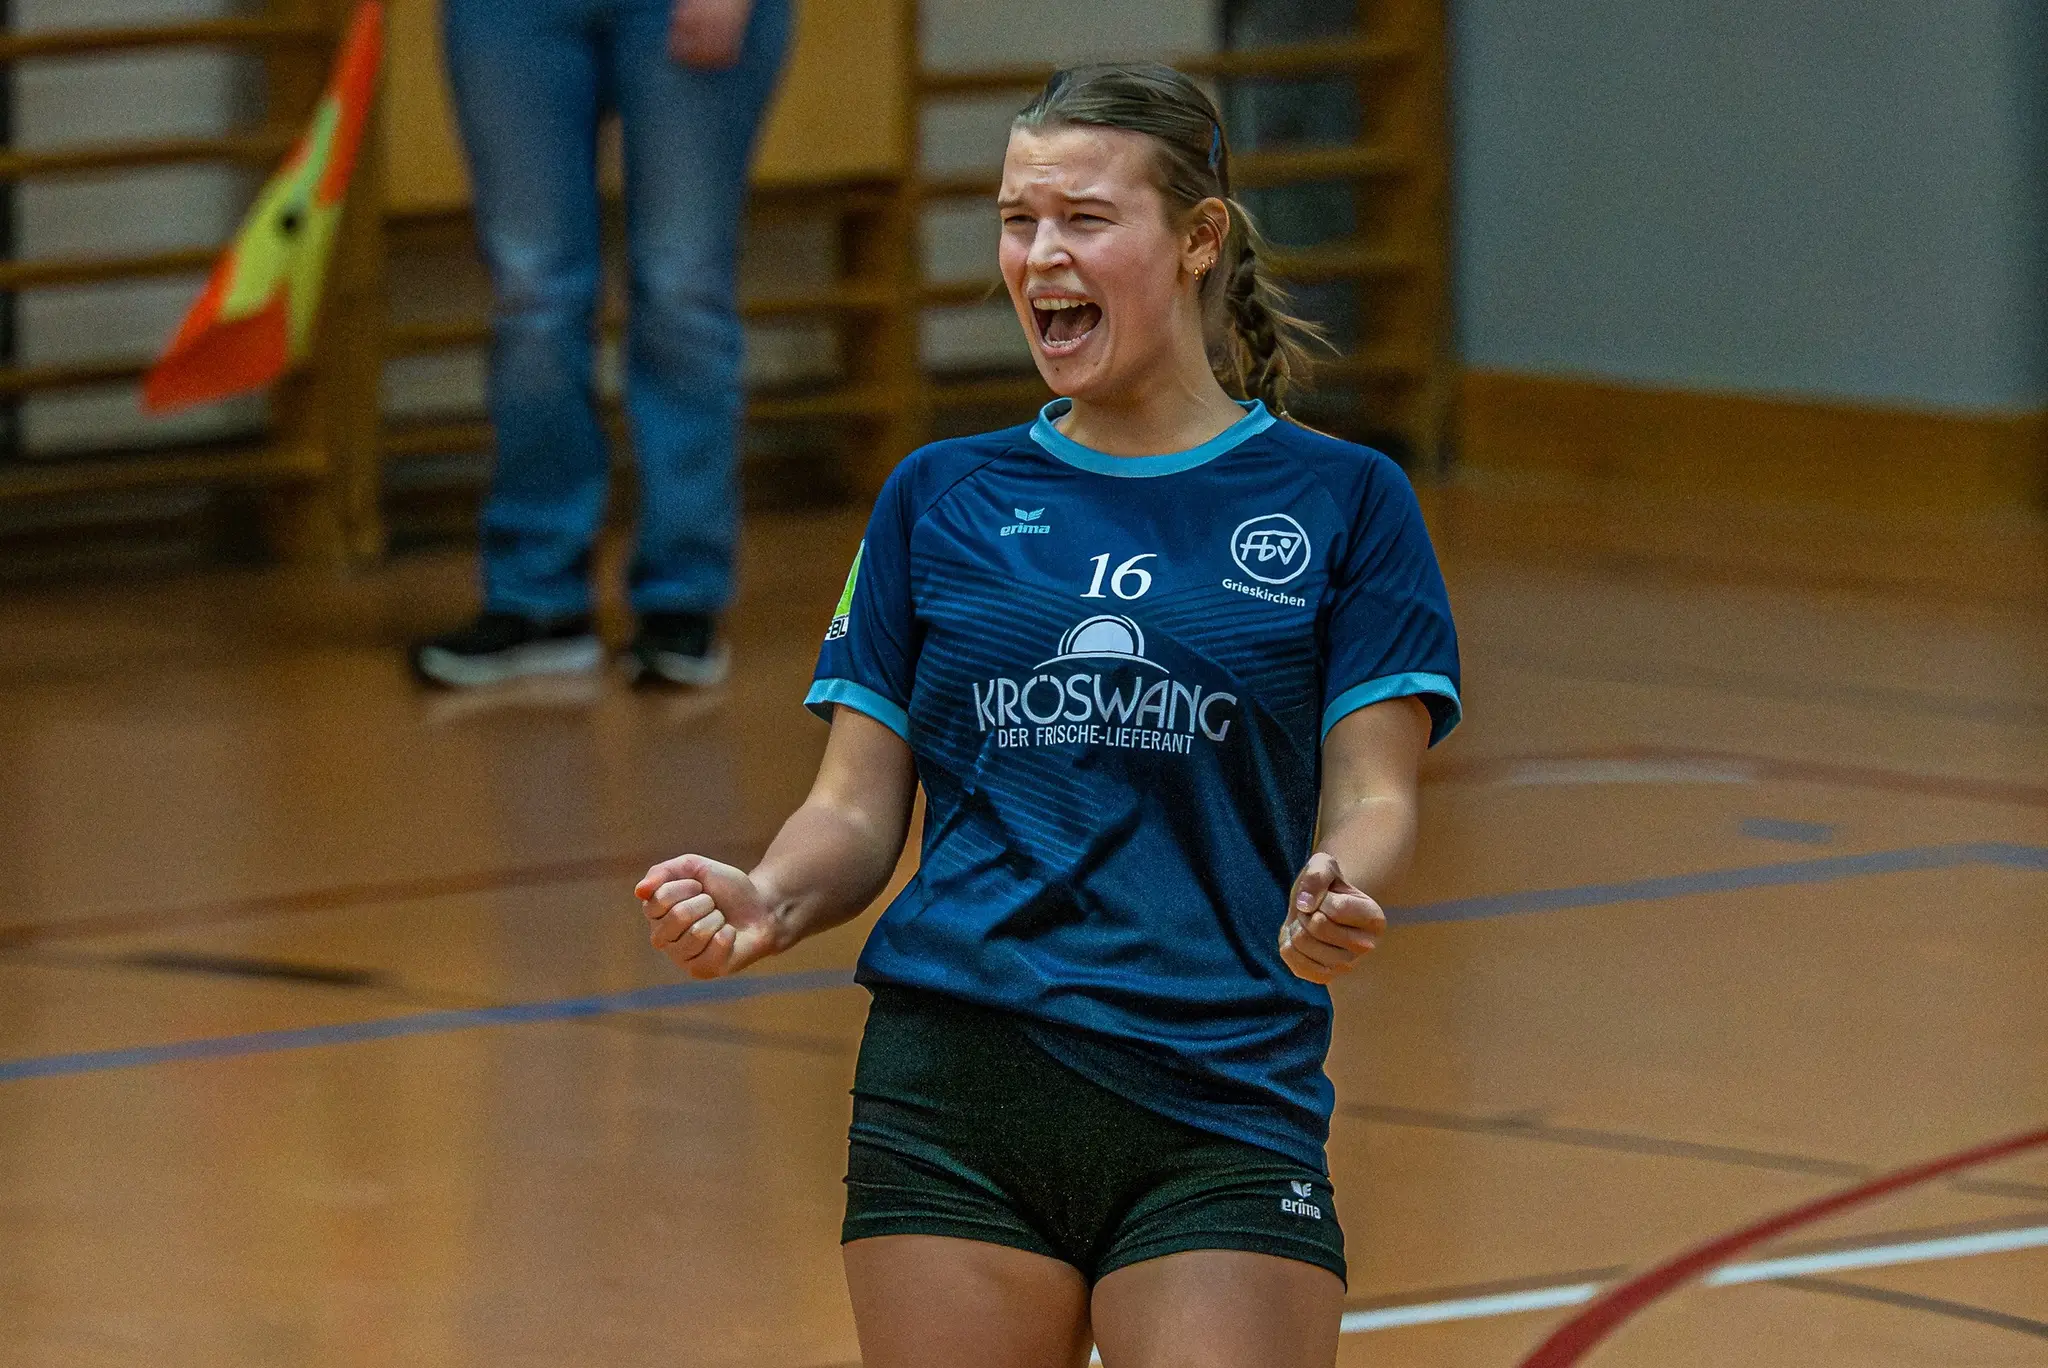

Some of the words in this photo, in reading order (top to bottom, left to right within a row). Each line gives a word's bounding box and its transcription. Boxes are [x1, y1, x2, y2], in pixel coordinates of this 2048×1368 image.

[1000, 522, 1050, 537] erima
[1079, 552, 1158, 600] 16
[1221, 578, 1306, 607] Grieskirchen
[826, 617, 847, 639] BL
[972, 673, 1238, 742] KRÖSWANG
[998, 727, 1030, 749] DER
[1035, 724, 1195, 755] FRISCHE-LIEFERANT
[1281, 1198, 1322, 1220] erima
